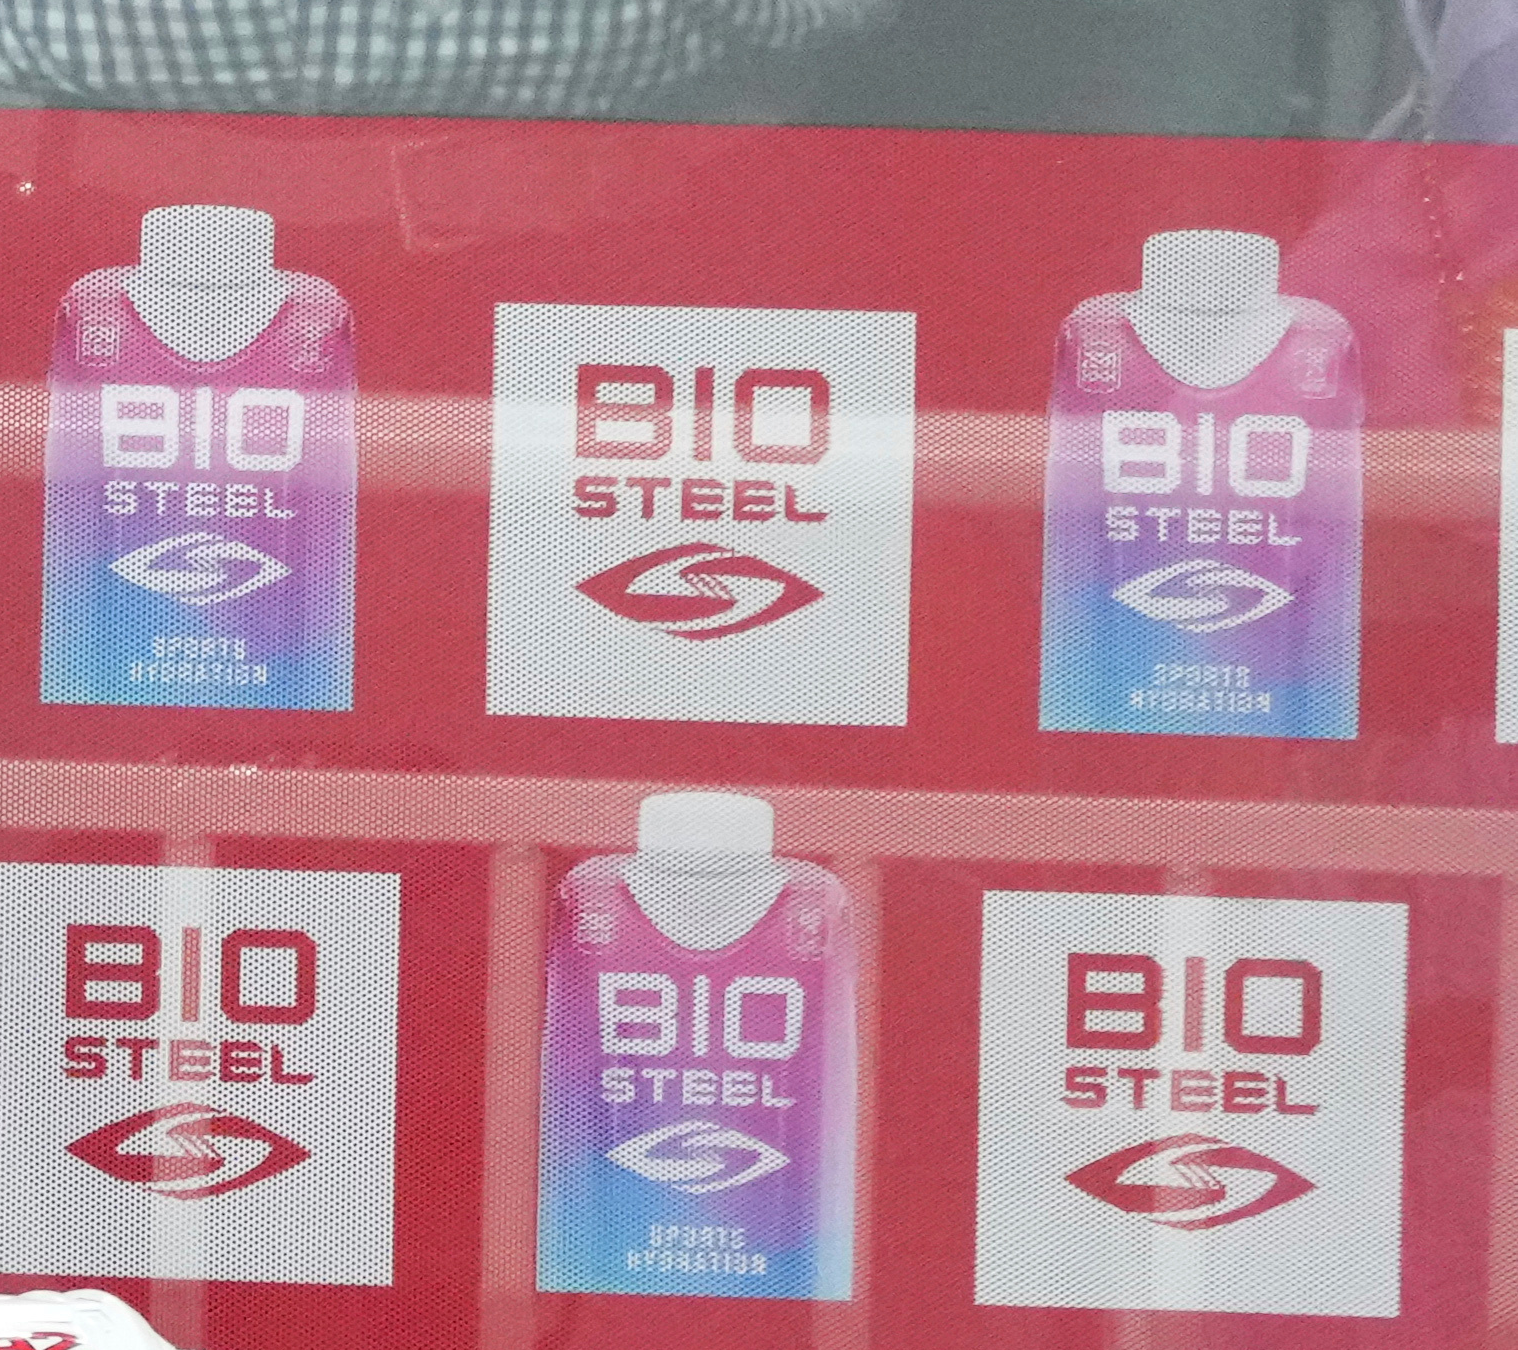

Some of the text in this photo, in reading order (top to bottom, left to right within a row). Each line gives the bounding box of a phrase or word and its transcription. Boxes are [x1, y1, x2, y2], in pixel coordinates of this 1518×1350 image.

[100, 383, 304, 473] BIO
[575, 364, 830, 465] BIO
[1102, 410, 1308, 497] BIO
[103, 481, 298, 519] STEEL
[573, 475, 827, 524] STEEL
[1105, 505, 1301, 546] STEEL
[65, 923, 316, 1024] BIO
[1067, 952, 1323, 1055] BIO
[599, 972, 805, 1060] BIO
[63, 1034, 314, 1084] STEEL
[601, 1067, 794, 1108] STEEL
[1063, 1065, 1320, 1116] STEEL
